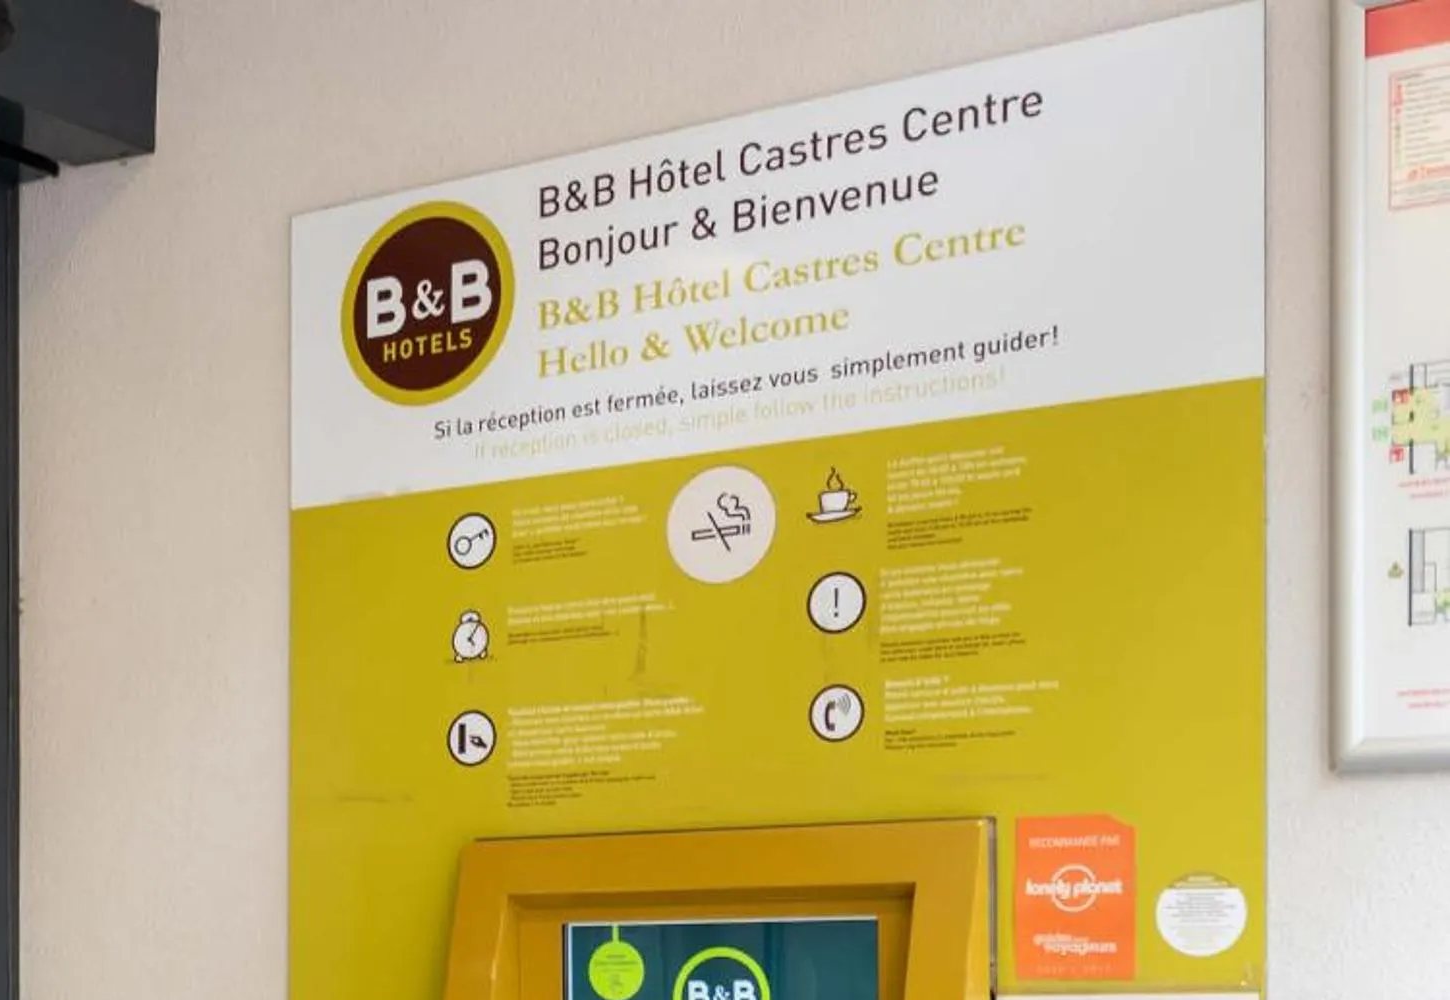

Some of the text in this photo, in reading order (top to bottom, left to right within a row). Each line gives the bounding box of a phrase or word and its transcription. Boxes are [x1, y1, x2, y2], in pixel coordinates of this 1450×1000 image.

[539, 90, 1044, 219] B&B Hôtel Castres Centre
[538, 169, 939, 271] Bonjour & Bienvenue
[366, 259, 493, 340] B&B
[538, 222, 1027, 331] B&B Hôtel Castres Centre
[383, 328, 474, 364] HOTELS
[434, 324, 1059, 440] Si la réception est fermée, laissez vous simplement guider!
[538, 309, 850, 379] Hello & Welcome
[1025, 877, 1123, 900] lonely planet
